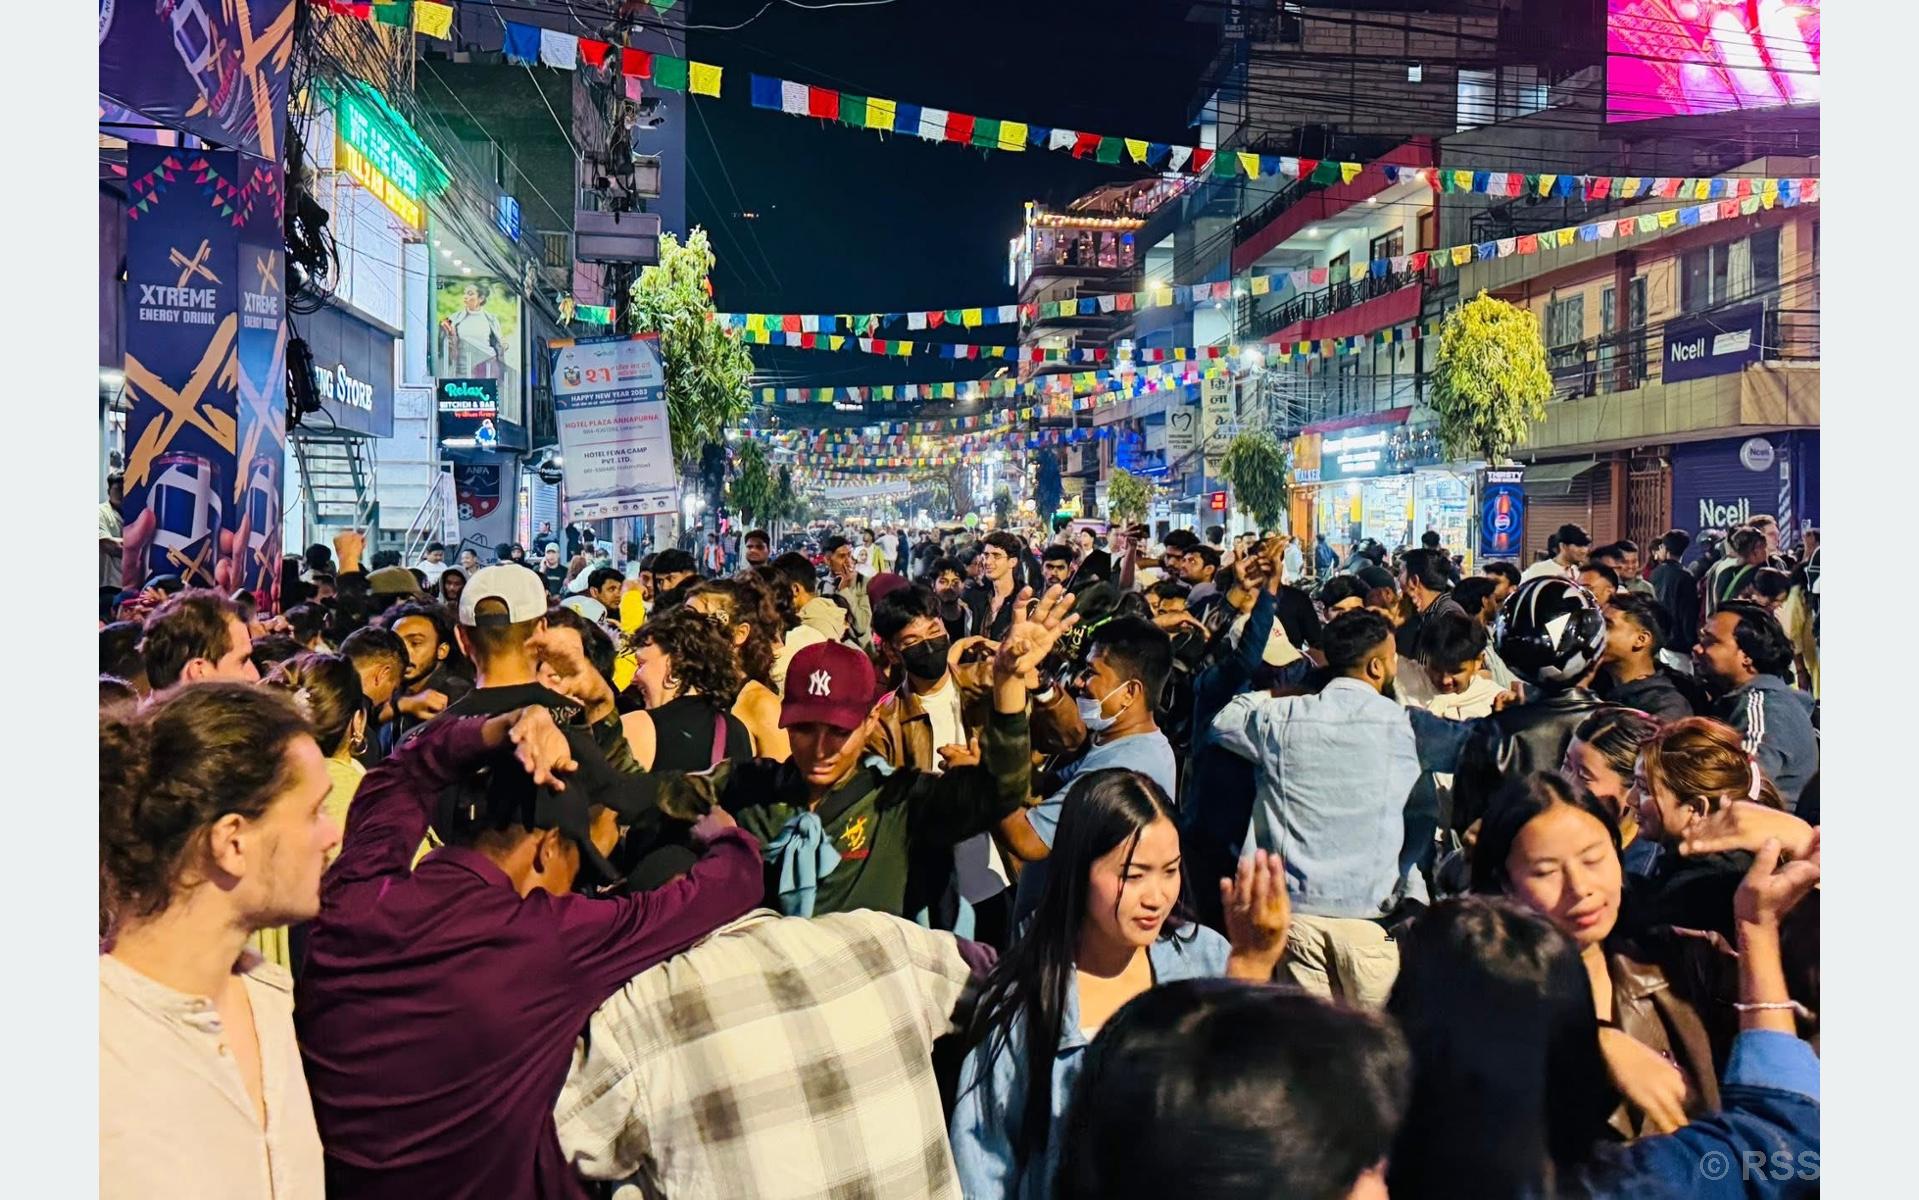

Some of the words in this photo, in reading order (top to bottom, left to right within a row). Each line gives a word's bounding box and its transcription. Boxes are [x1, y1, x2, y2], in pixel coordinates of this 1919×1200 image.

[140, 284, 216, 308] XTREME
[244, 292, 278, 315] XTREME
[140, 308, 180, 323] ENERGY
[183, 311, 216, 325] DRINK
[1671, 337, 1705, 362] Ncell
[444, 382, 490, 401] Relax
[571, 393, 594, 402] HAPPY
[595, 391, 611, 400] NEW
[612, 389, 630, 398] YEAR
[565, 421, 588, 429] HOTEL
[588, 419, 612, 427] PLAZA
[613, 414, 659, 425] ANNAPURNA
[584, 450, 605, 458] HOTEL
[626, 446, 648, 454] CAMP
[1749, 447, 1770, 456] Ncell
[1699, 497, 1750, 527] Ncell
